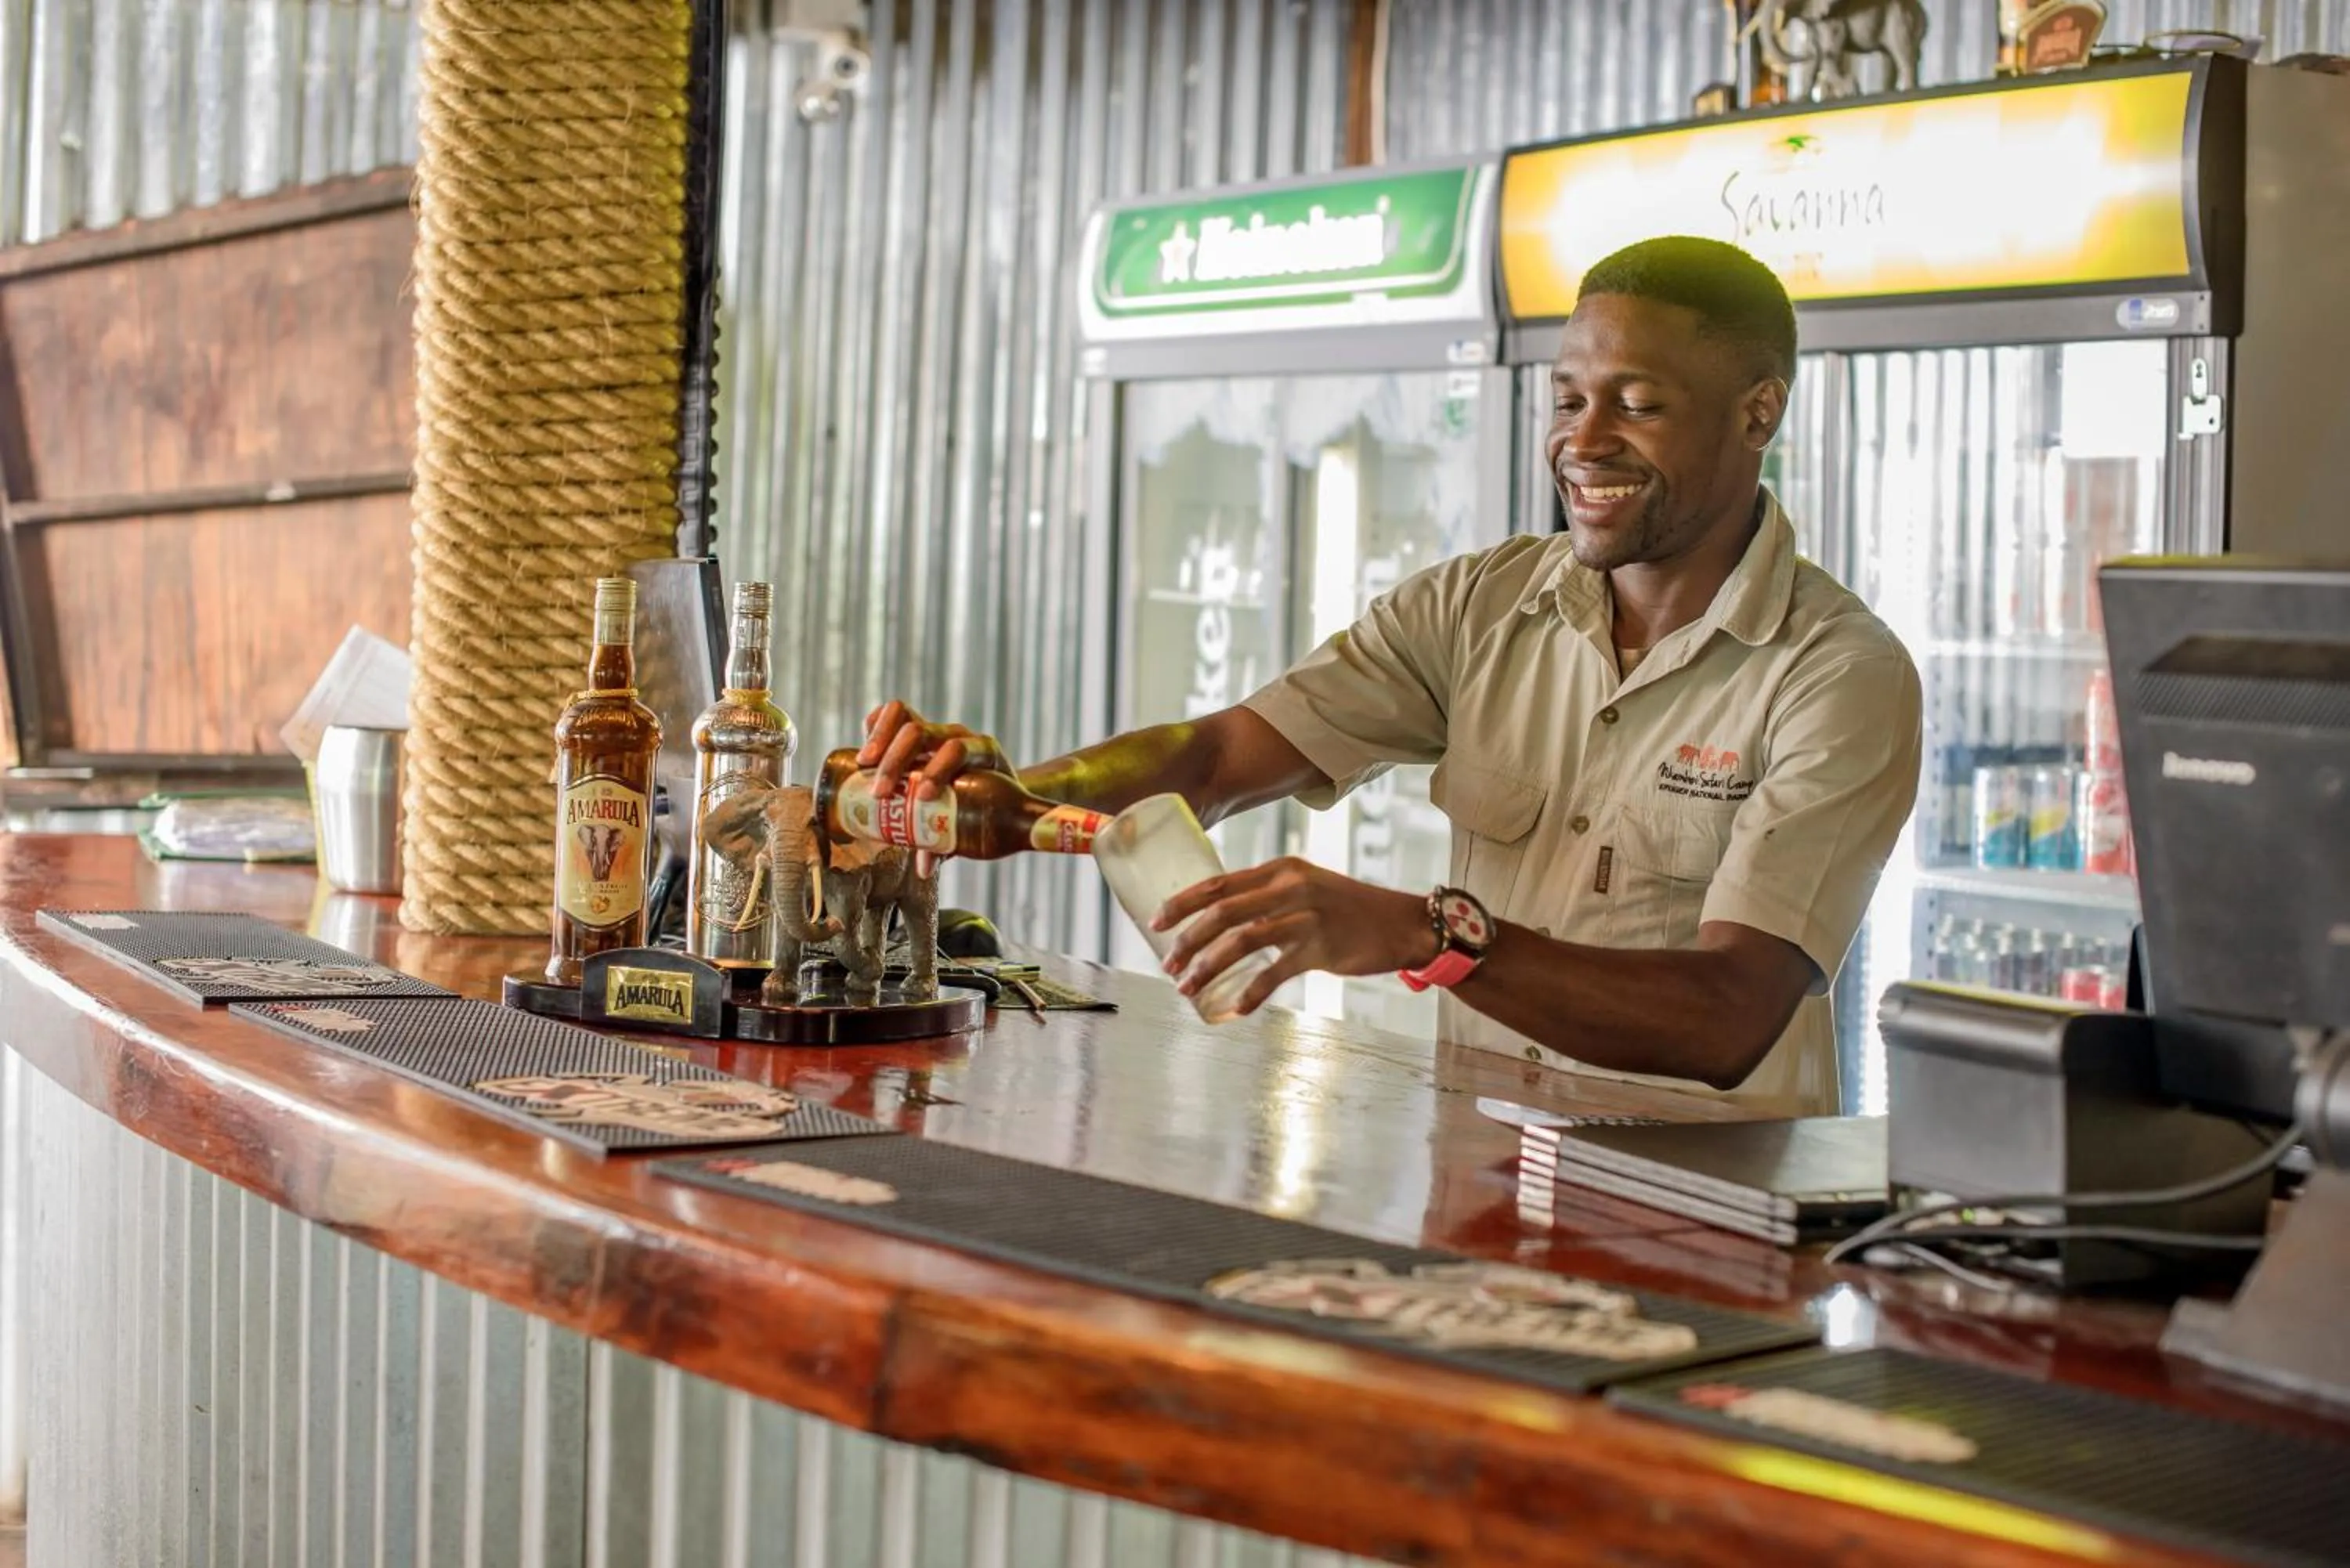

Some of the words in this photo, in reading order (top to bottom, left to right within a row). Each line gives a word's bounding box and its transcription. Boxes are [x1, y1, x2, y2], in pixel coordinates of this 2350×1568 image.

[1720, 169, 1885, 242] Savanna
[1726, 774, 1754, 794] Camp
[566, 798, 640, 828] AMARULA
[614, 984, 685, 1017] AMARULA
